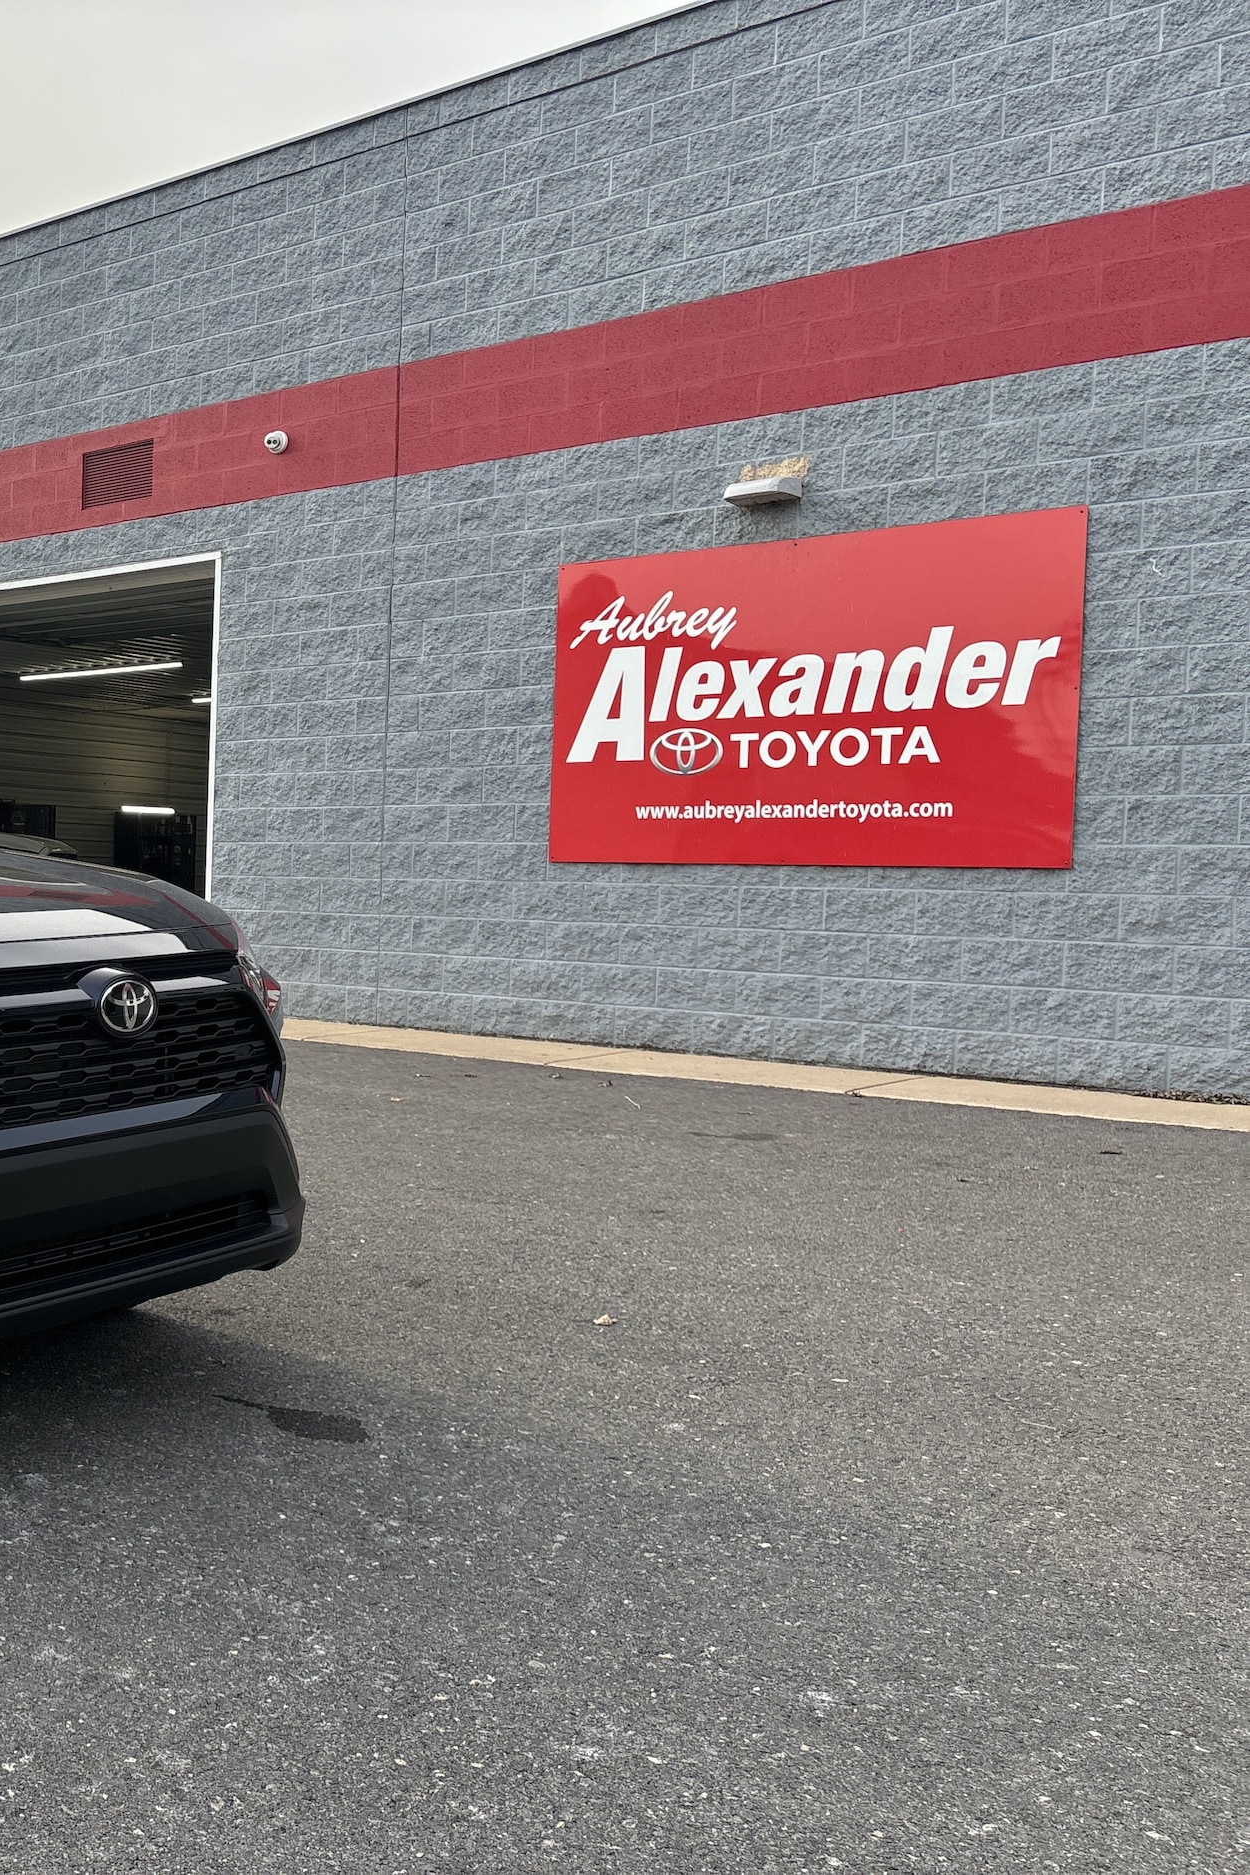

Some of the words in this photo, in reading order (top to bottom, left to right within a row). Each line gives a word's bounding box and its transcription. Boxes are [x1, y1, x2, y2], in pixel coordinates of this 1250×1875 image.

[570, 590, 737, 650] Aubrey
[566, 625, 1062, 764] Alexander
[729, 726, 941, 769] TOYOTA
[635, 798, 953, 824] www.aubreyalexandertoyota.com
